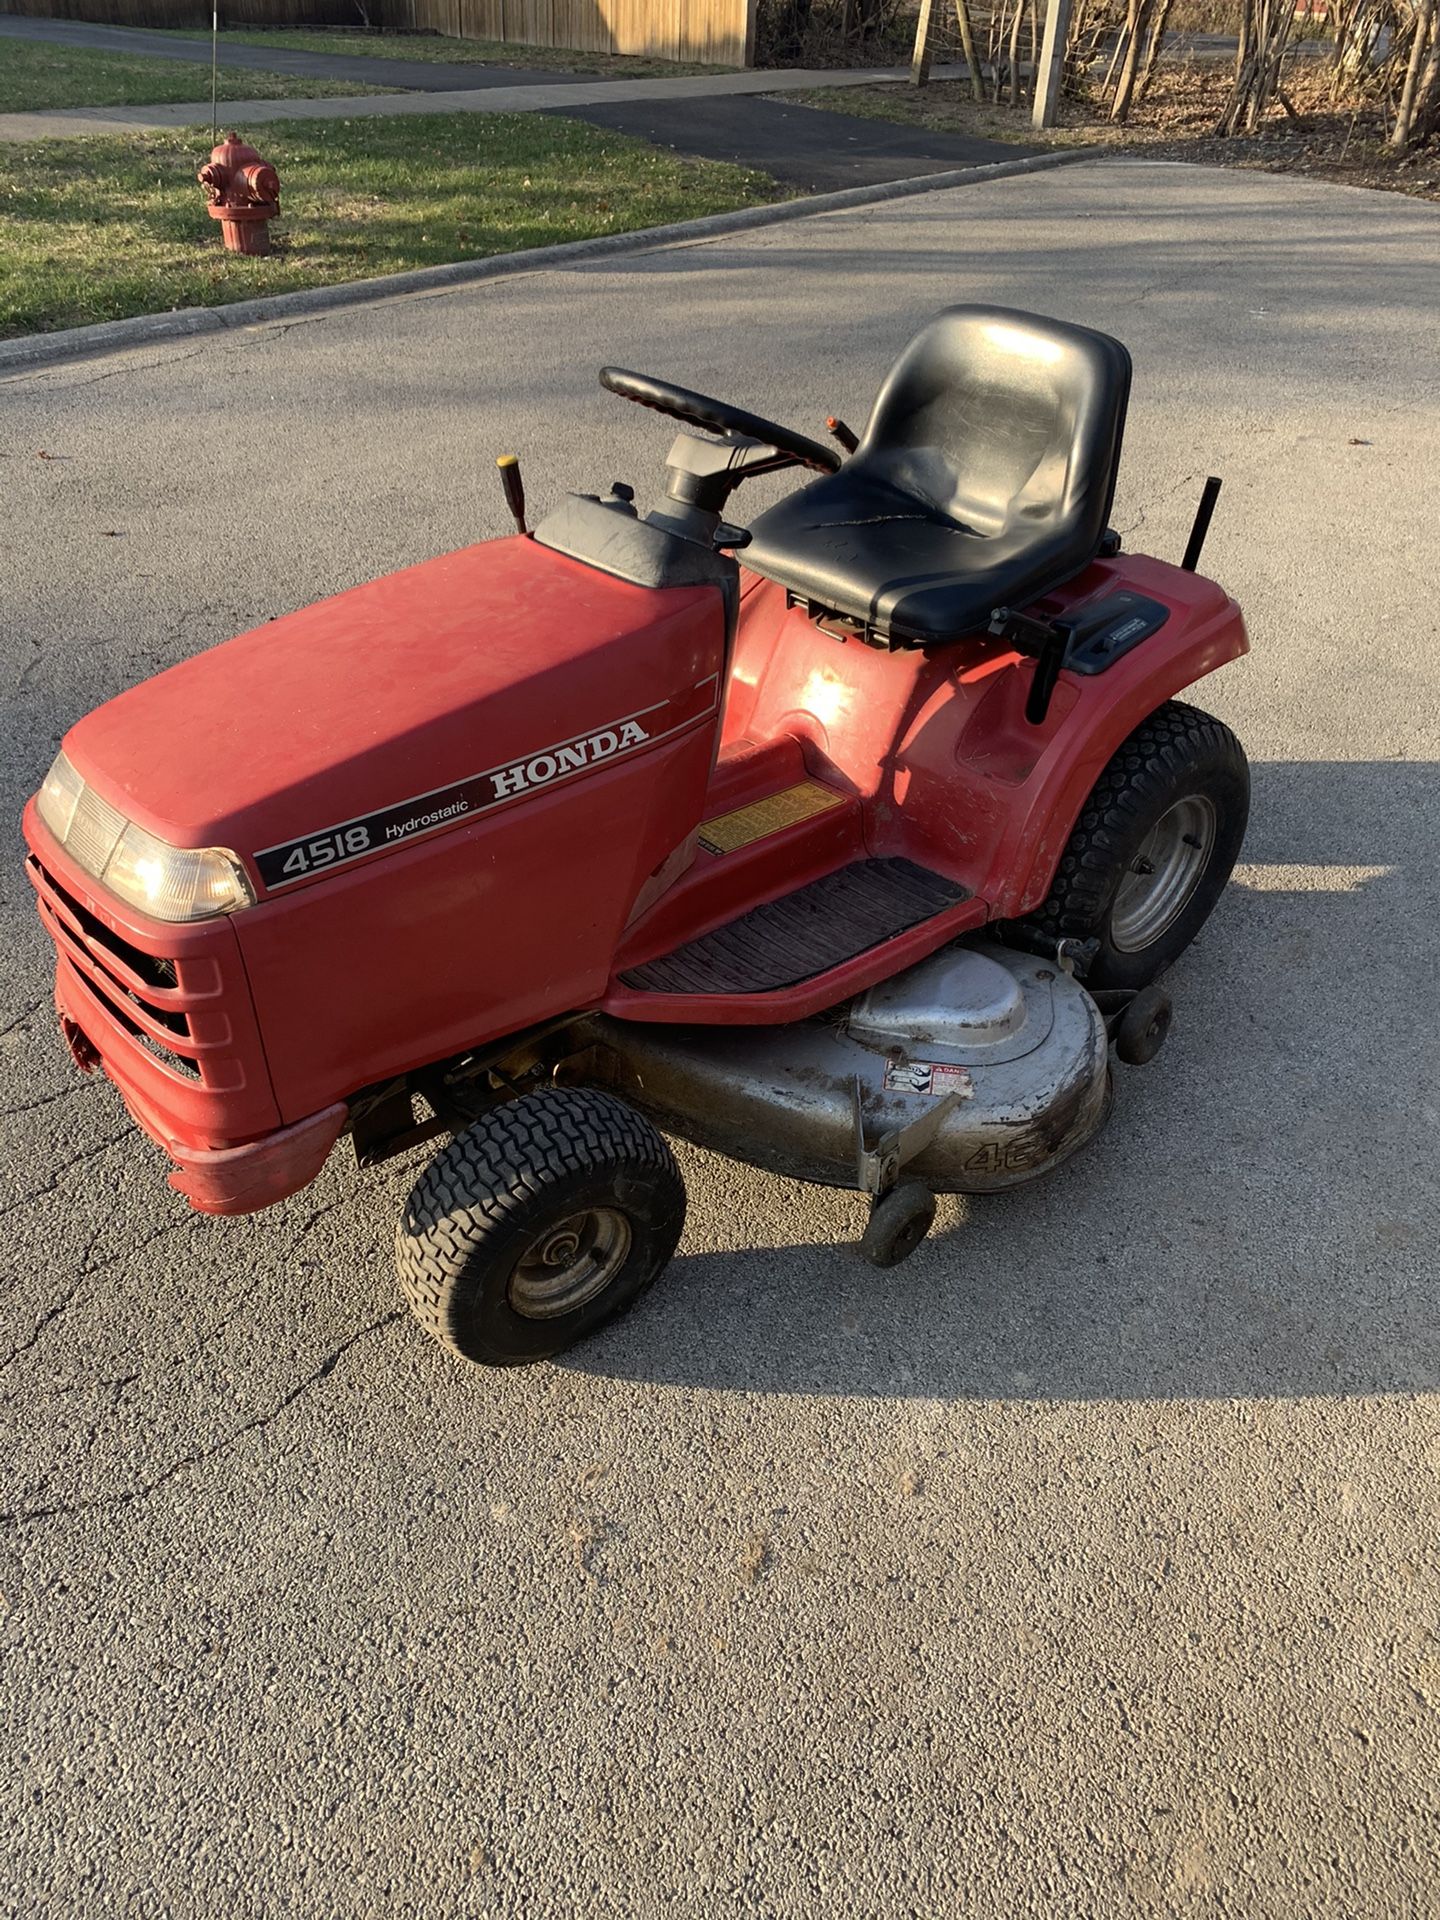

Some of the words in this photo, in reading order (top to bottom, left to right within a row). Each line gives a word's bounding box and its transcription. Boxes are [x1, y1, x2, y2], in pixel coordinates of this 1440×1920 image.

[282, 826, 371, 874] 4518
[386, 800, 469, 839] Hydrostatic
[489, 720, 649, 799] HONDA
